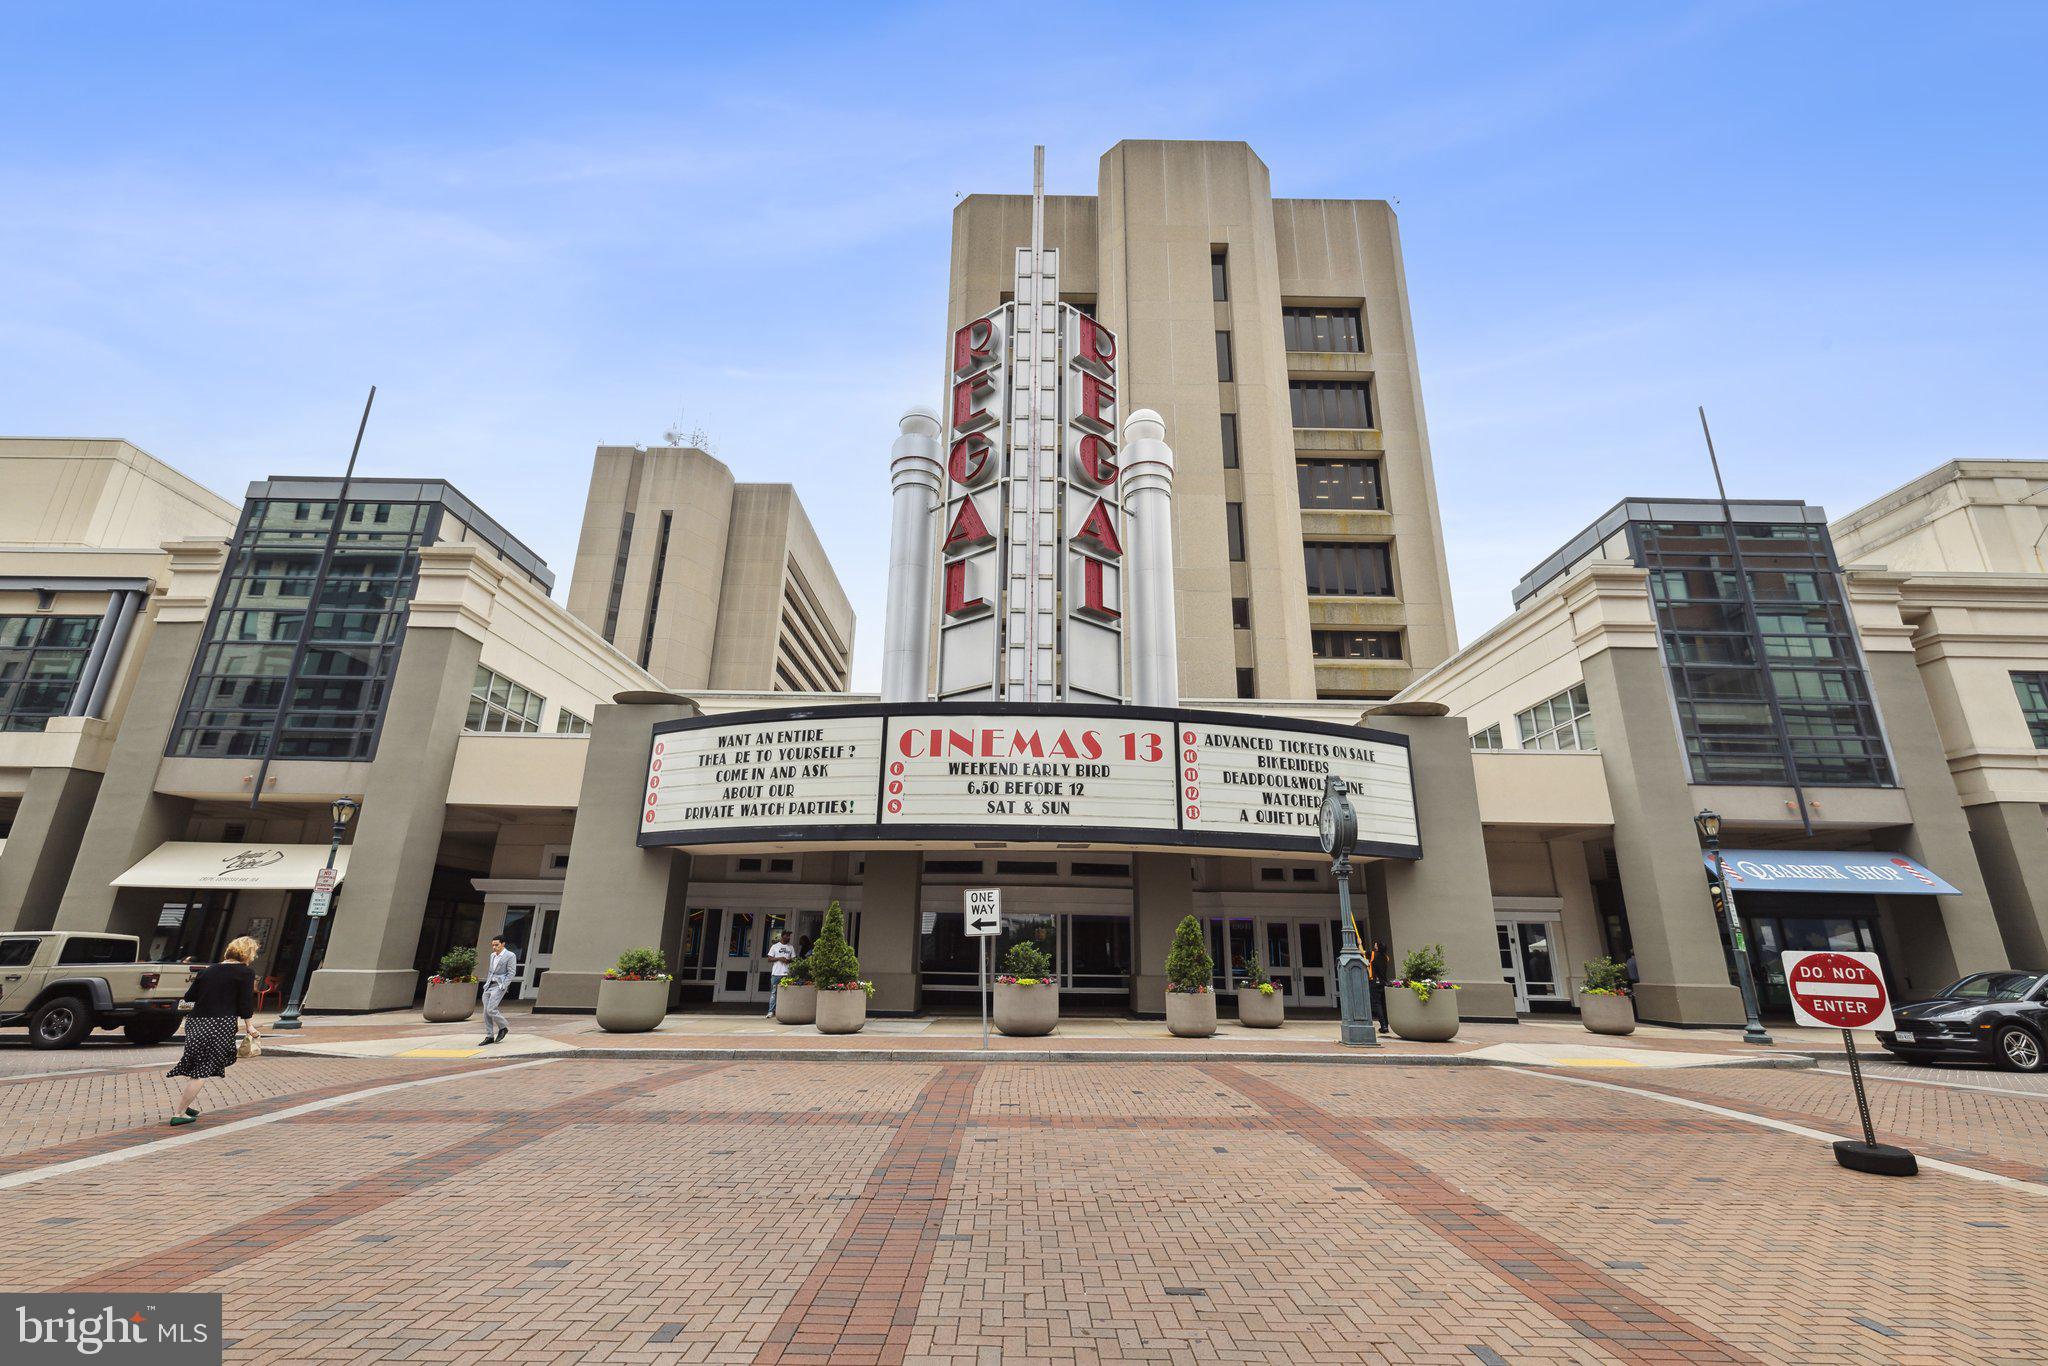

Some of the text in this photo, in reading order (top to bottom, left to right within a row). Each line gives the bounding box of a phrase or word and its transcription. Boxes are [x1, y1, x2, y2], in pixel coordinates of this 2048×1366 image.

[942, 317, 998, 616] REGAL
[1070, 313, 1124, 622] REGAL
[718, 729, 824, 747] WANT AN ENTIRE
[900, 728, 1163, 762] CINEMAS 13
[757, 749, 772, 761] TO
[1205, 734, 1375, 762] ADVANCED TICKETS ON SALE
[949, 762, 1110, 778] WEEKEND EARLY BIRD
[1258, 756, 1329, 773] BIKERIDERS
[716, 764, 828, 782] COME IN AND ASK
[722, 784, 794, 799] ABOUT OUR
[968, 782, 1084, 796] 6.50 BEFORE 12
[685, 800, 854, 820] PRIVATE WATCH PARTIES!
[988, 801, 1070, 814] SAT & SUN
[1240, 810, 1248, 822] A
[1256, 811, 1292, 825] QUIET
[1845, 866, 1904, 880] SHOP
[971, 892, 994, 902] ONE
[971, 904, 995, 915] WAY
[1800, 966, 1865, 980] DO NOT
[1813, 1000, 1868, 1014] ENTER
